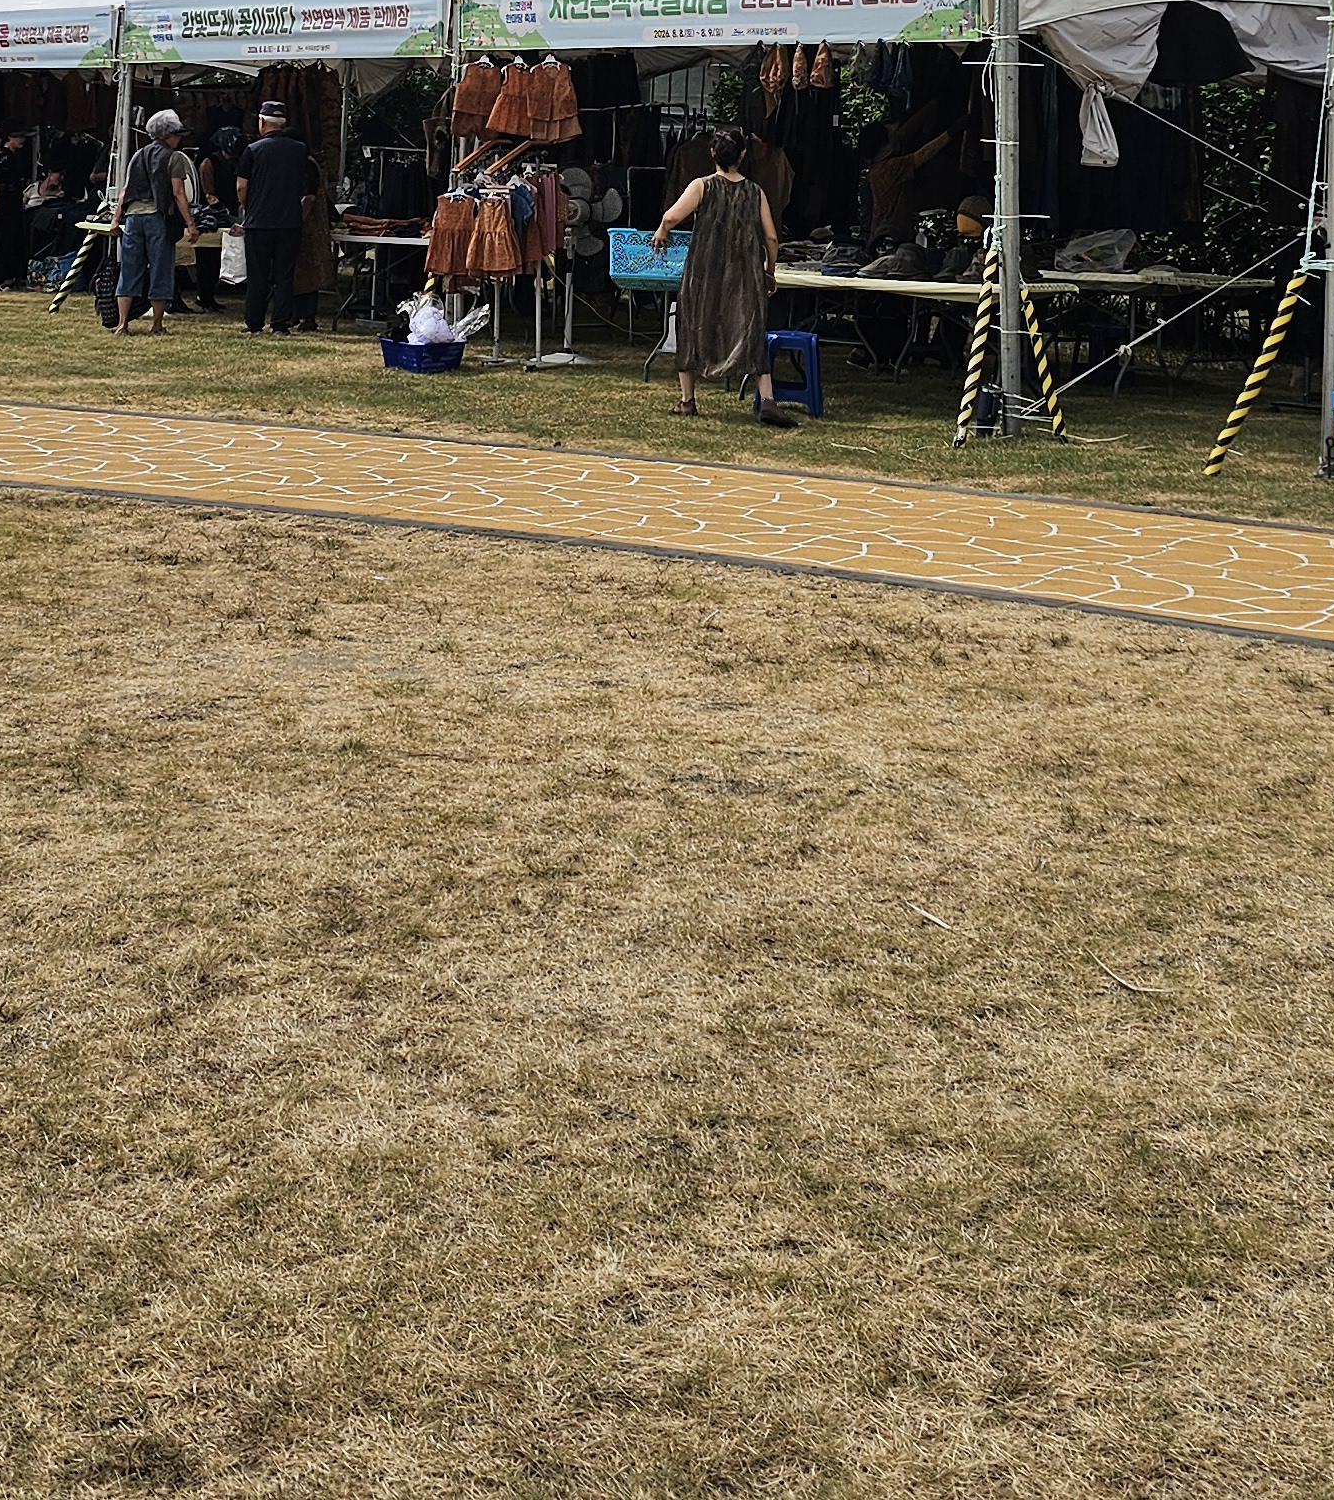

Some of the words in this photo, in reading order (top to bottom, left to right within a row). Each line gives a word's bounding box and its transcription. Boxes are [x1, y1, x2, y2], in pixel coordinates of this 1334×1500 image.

[301, 7, 346, 31] 천연염색
[347, 6, 371, 29] 제품
[373, 4, 410, 29] 판매장
